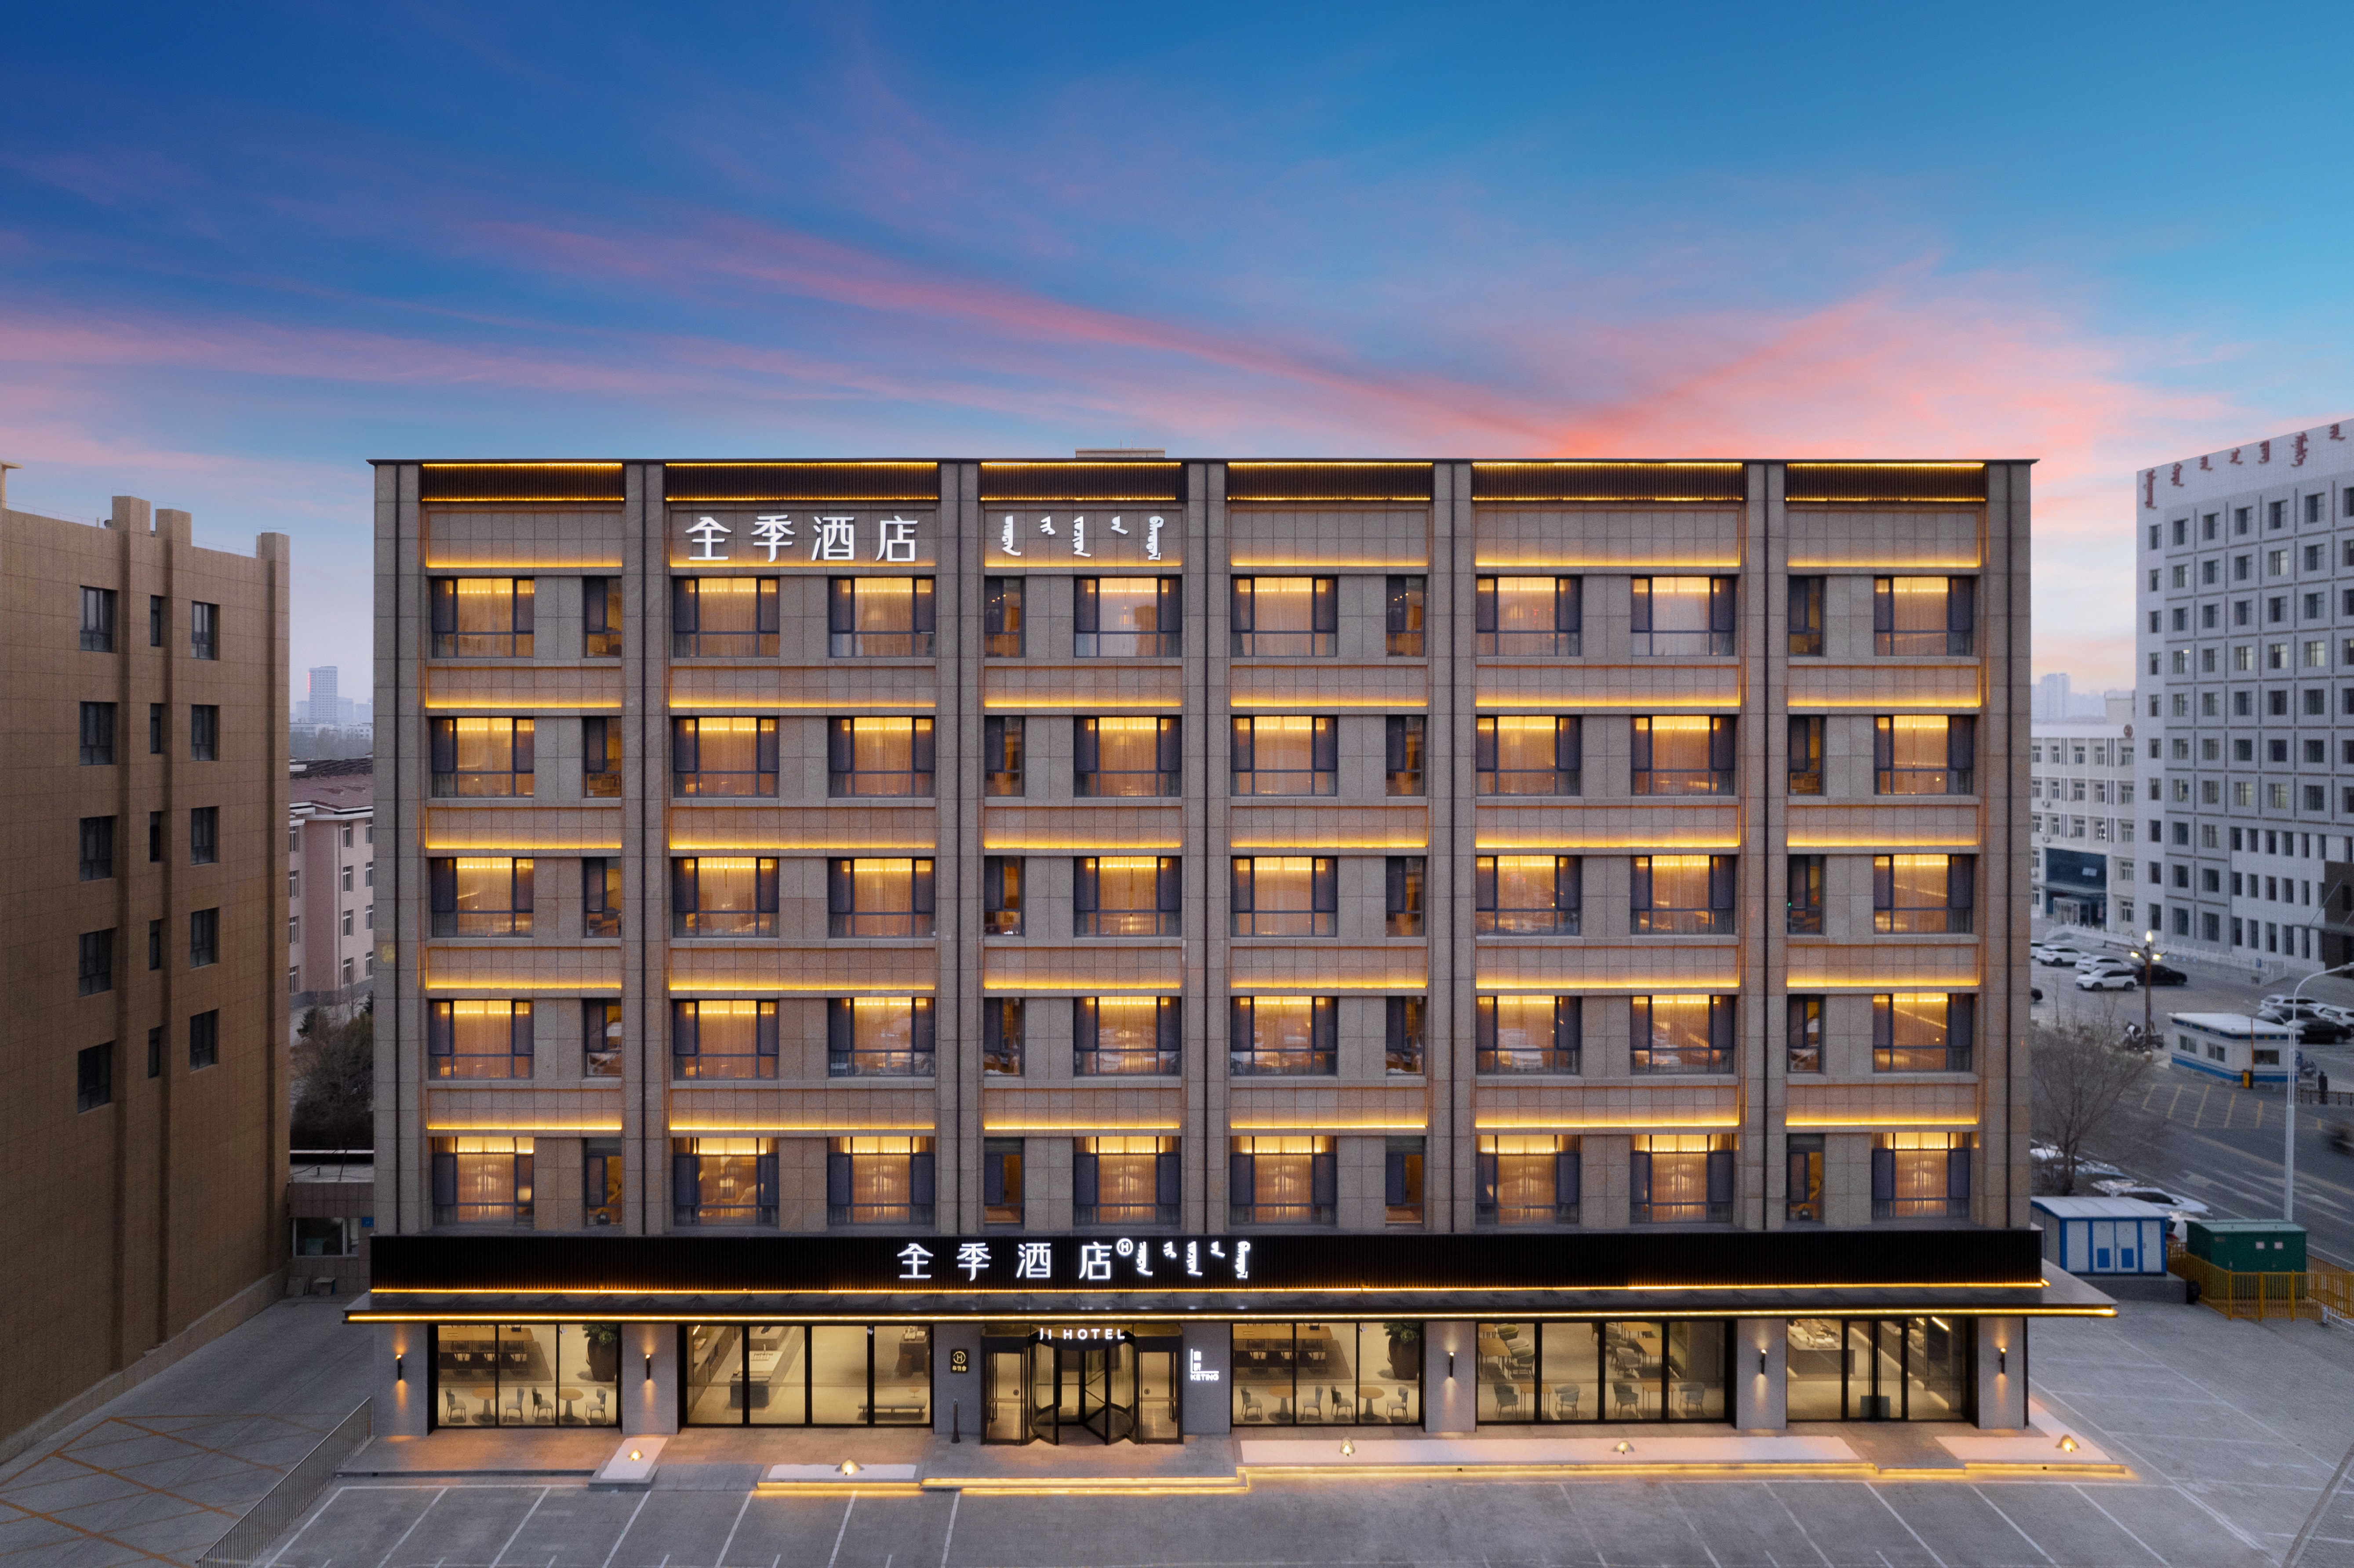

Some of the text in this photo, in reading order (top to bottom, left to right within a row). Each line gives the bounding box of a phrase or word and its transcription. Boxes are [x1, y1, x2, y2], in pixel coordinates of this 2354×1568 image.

[686, 515, 917, 562] 全季酒店
[898, 1242, 1112, 1281] 全季酒店
[1041, 1328, 1124, 1339] JI HOTEL
